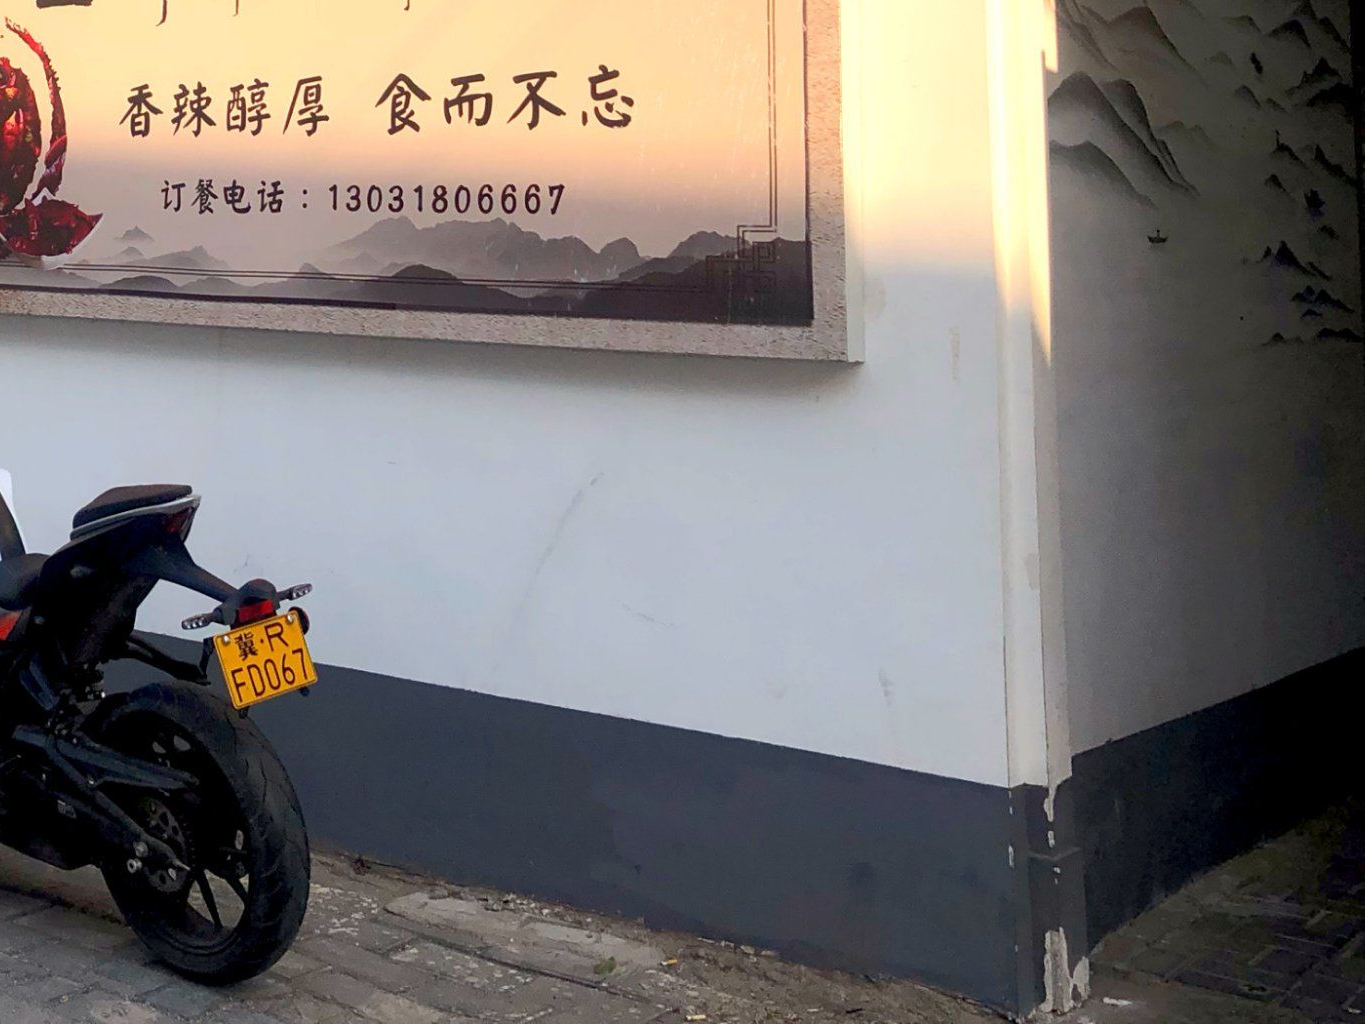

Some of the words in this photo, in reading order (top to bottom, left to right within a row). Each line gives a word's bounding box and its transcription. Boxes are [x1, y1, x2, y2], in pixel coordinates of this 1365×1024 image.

[118, 75, 330, 138] 香辣醇厚
[374, 64, 635, 136] 食而不忘
[230, 647, 309, 703] FD067
